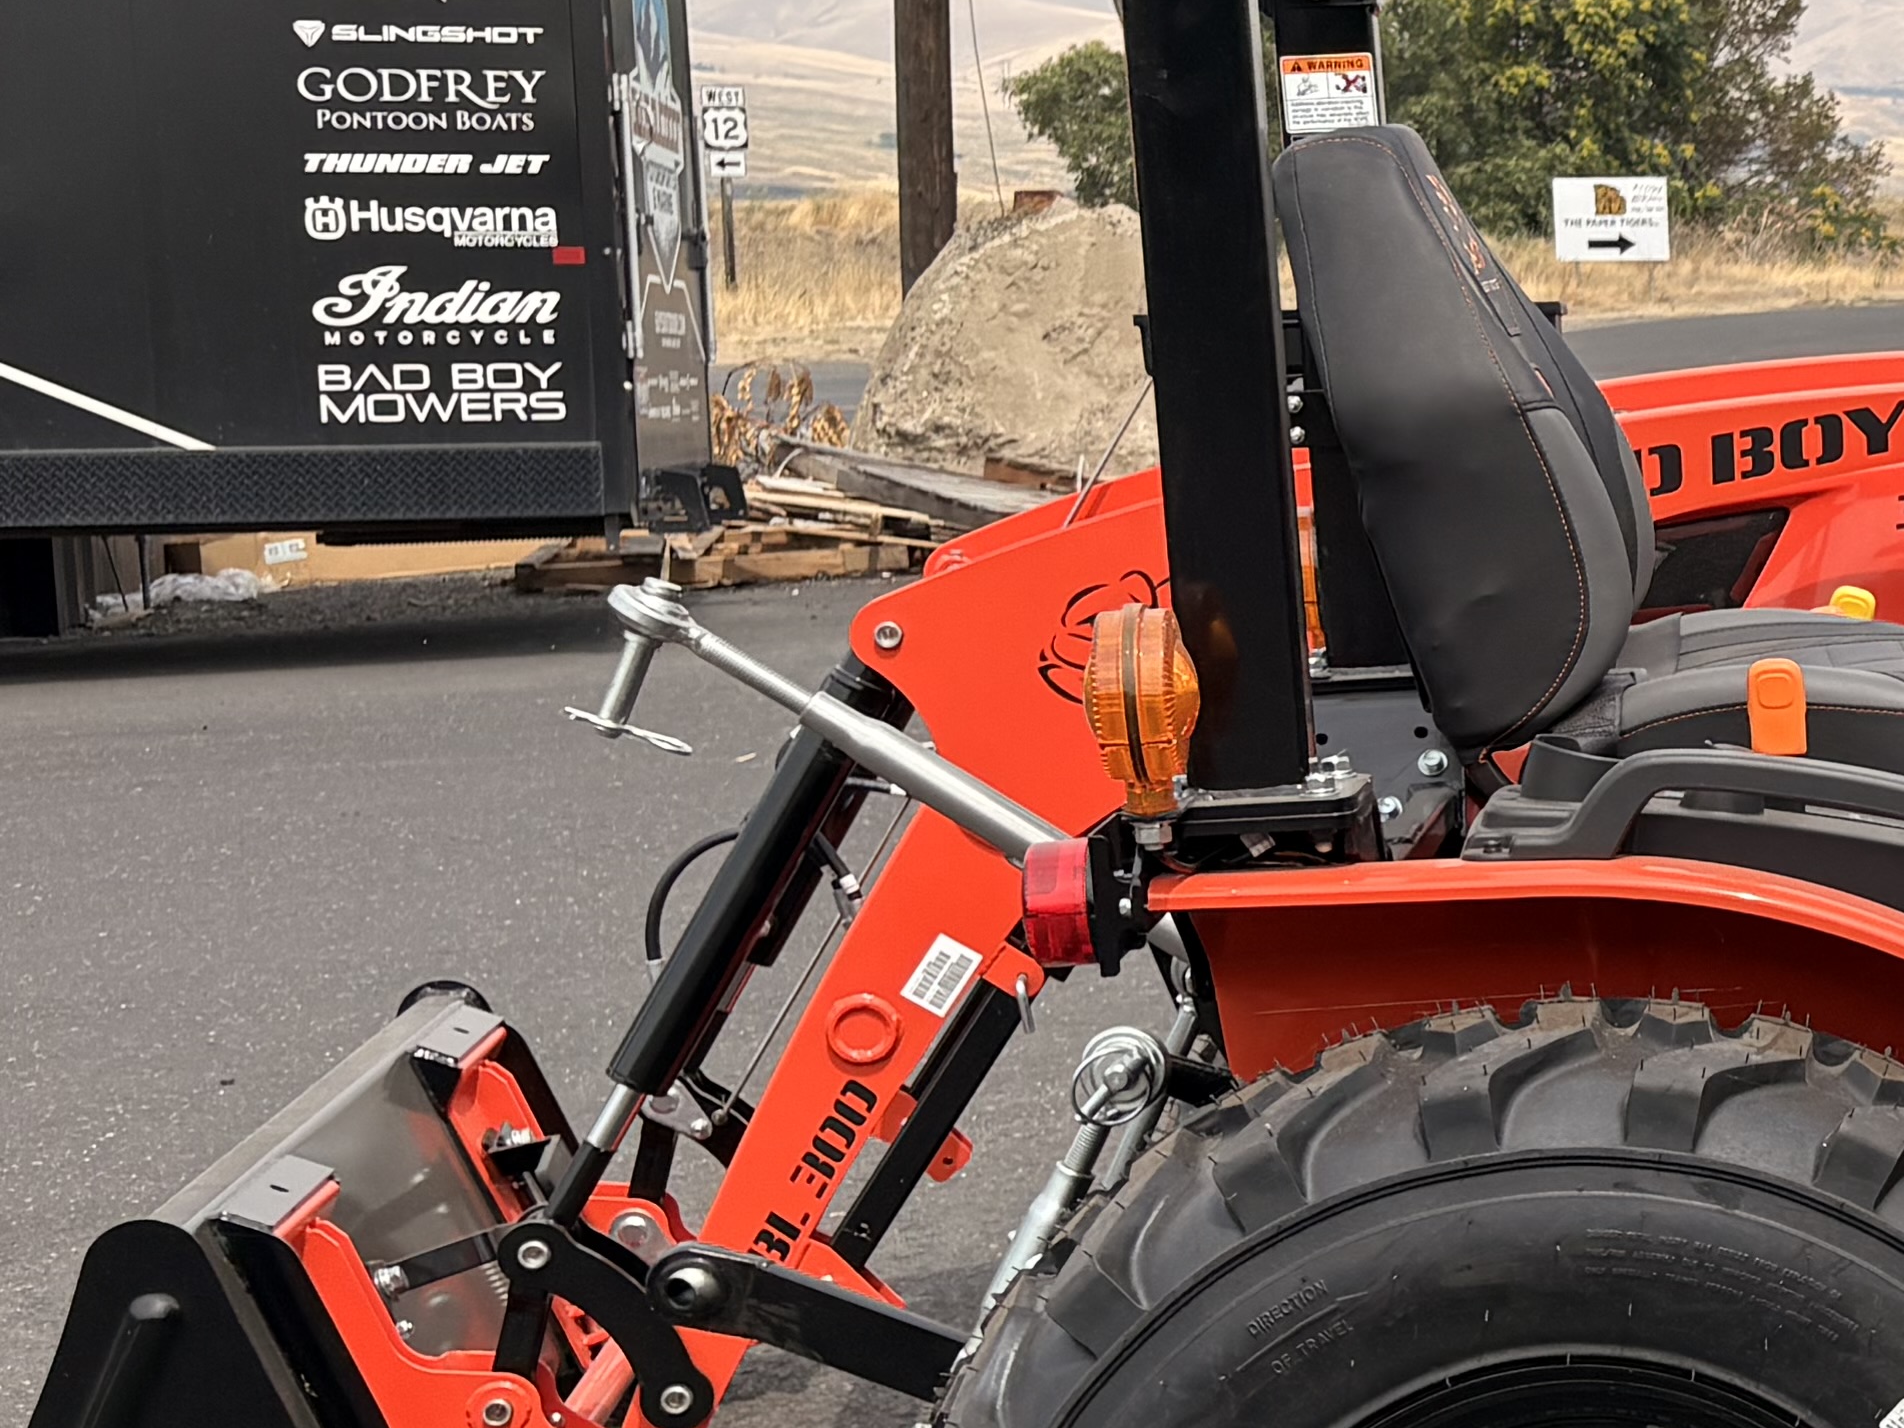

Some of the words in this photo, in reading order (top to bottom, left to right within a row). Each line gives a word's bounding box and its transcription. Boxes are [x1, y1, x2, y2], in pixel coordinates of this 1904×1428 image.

[331, 24, 544, 45] SLINGSHOT
[1306, 59, 1364, 70] WARNING
[296, 66, 547, 110] GODFREY
[706, 89, 739, 103] WEST
[711, 116, 740, 141] 12
[303, 152, 474, 174] THUNDER
[478, 154, 551, 174] JET
[350, 199, 558, 238] Husqvarna
[1564, 218, 1582, 228] THE
[1586, 218, 1616, 229] PAPER
[454, 234, 559, 248] MOTORCYCLES
[311, 265, 562, 327] Indian
[324, 329, 556, 346] MOTORCYCLE
[317, 363, 431, 392] BAD
[451, 361, 563, 391] BOY
[318, 391, 567, 424] MOWERS
[748, 1211, 810, 1262] BL
[789, 1079, 878, 1199] 300
[1246, 1279, 1329, 1339] DIRECTION
[1271, 1353, 1292, 1374] OF
[1296, 1319, 1354, 1356] TRAVEL
